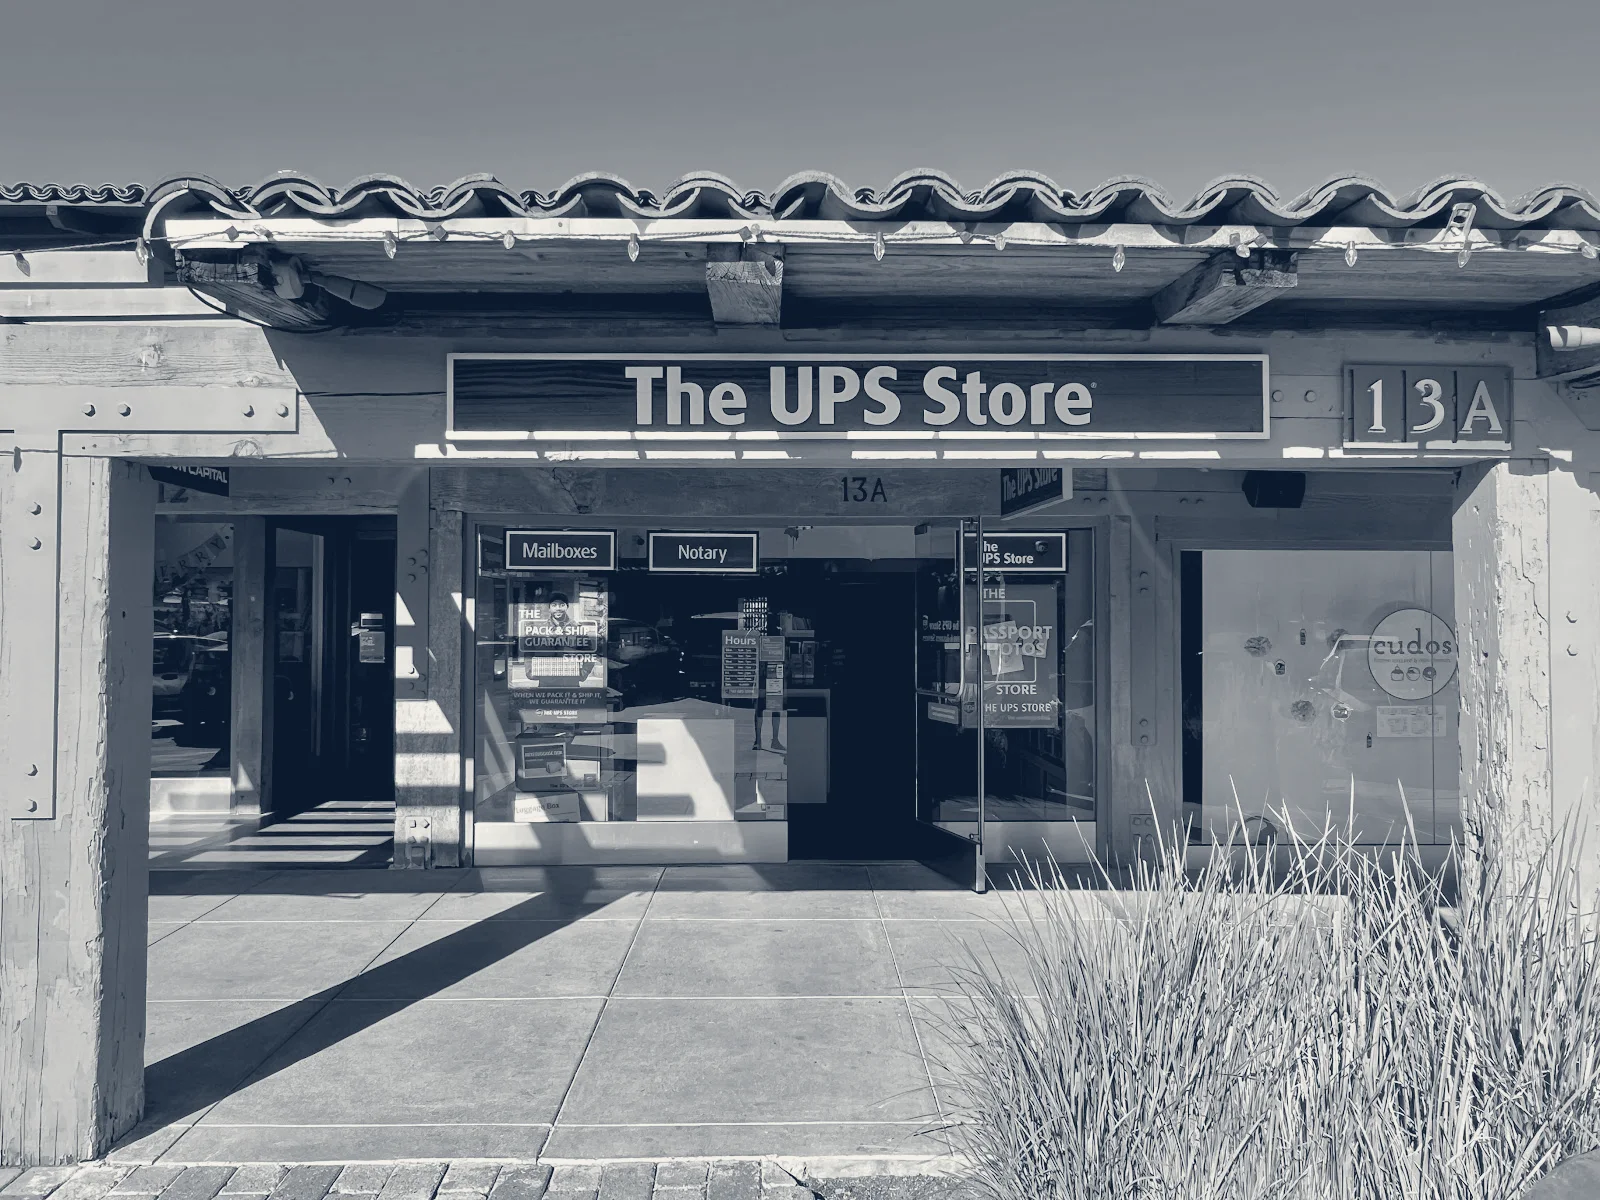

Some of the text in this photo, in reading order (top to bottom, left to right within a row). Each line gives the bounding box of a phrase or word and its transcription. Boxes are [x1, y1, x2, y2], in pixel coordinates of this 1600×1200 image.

[625, 366, 1093, 425] The UPS Store
[1367, 378, 1503, 434] 13A
[188, 465, 228, 484] CAPITAL
[841, 476, 888, 503] 13A
[1003, 468, 1058, 503] The UPS Store
[522, 542, 598, 559] Mailboxes
[983, 541, 999, 552] he
[678, 544, 728, 564] Notary
[1003, 552, 1035, 565] Store
[983, 588, 1006, 599] THE
[518, 609, 541, 619] THE
[525, 626, 590, 636] PACK & SHIP
[524, 637, 589, 648] GUARANTEE
[725, 635, 757, 645] Hours
[1373, 628, 1453, 655] cudos
[983, 642, 1046, 656] HOTOS
[563, 653, 598, 663] STORE
[996, 684, 1038, 695] STORE
[985, 703, 998, 713] HE
[1000, 703, 1019, 713] UPS
[1021, 703, 1051, 713] STORE
[515, 804, 545, 815] Luggage
